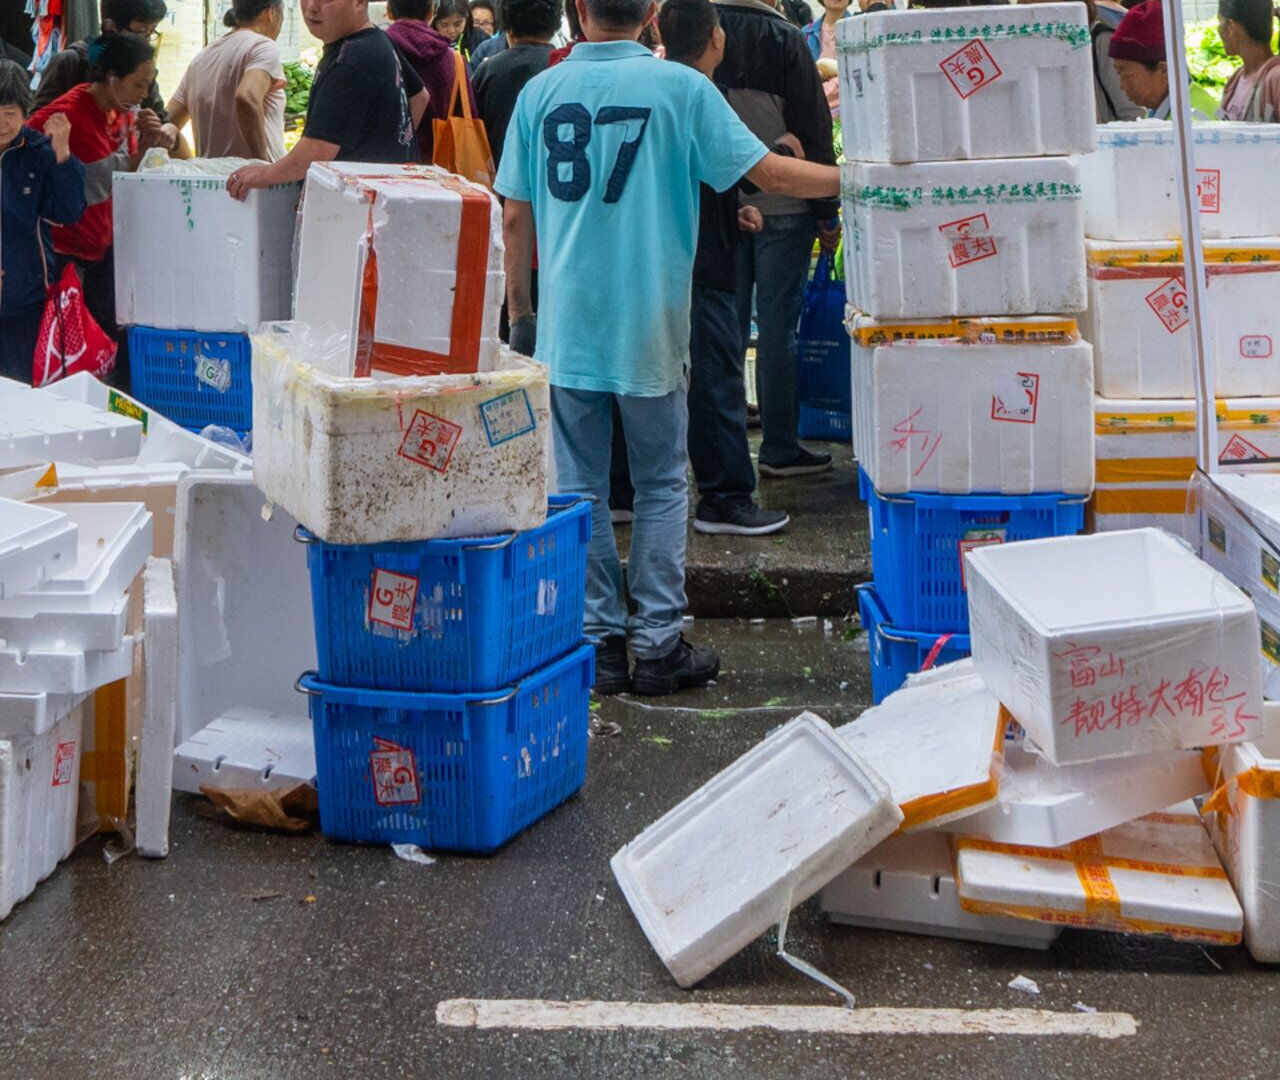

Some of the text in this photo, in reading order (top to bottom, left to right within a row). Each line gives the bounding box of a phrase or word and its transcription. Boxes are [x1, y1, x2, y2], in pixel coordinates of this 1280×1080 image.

[543, 102, 652, 204] 87
[376, 587, 394, 606] G
[393, 766, 413, 785] G
